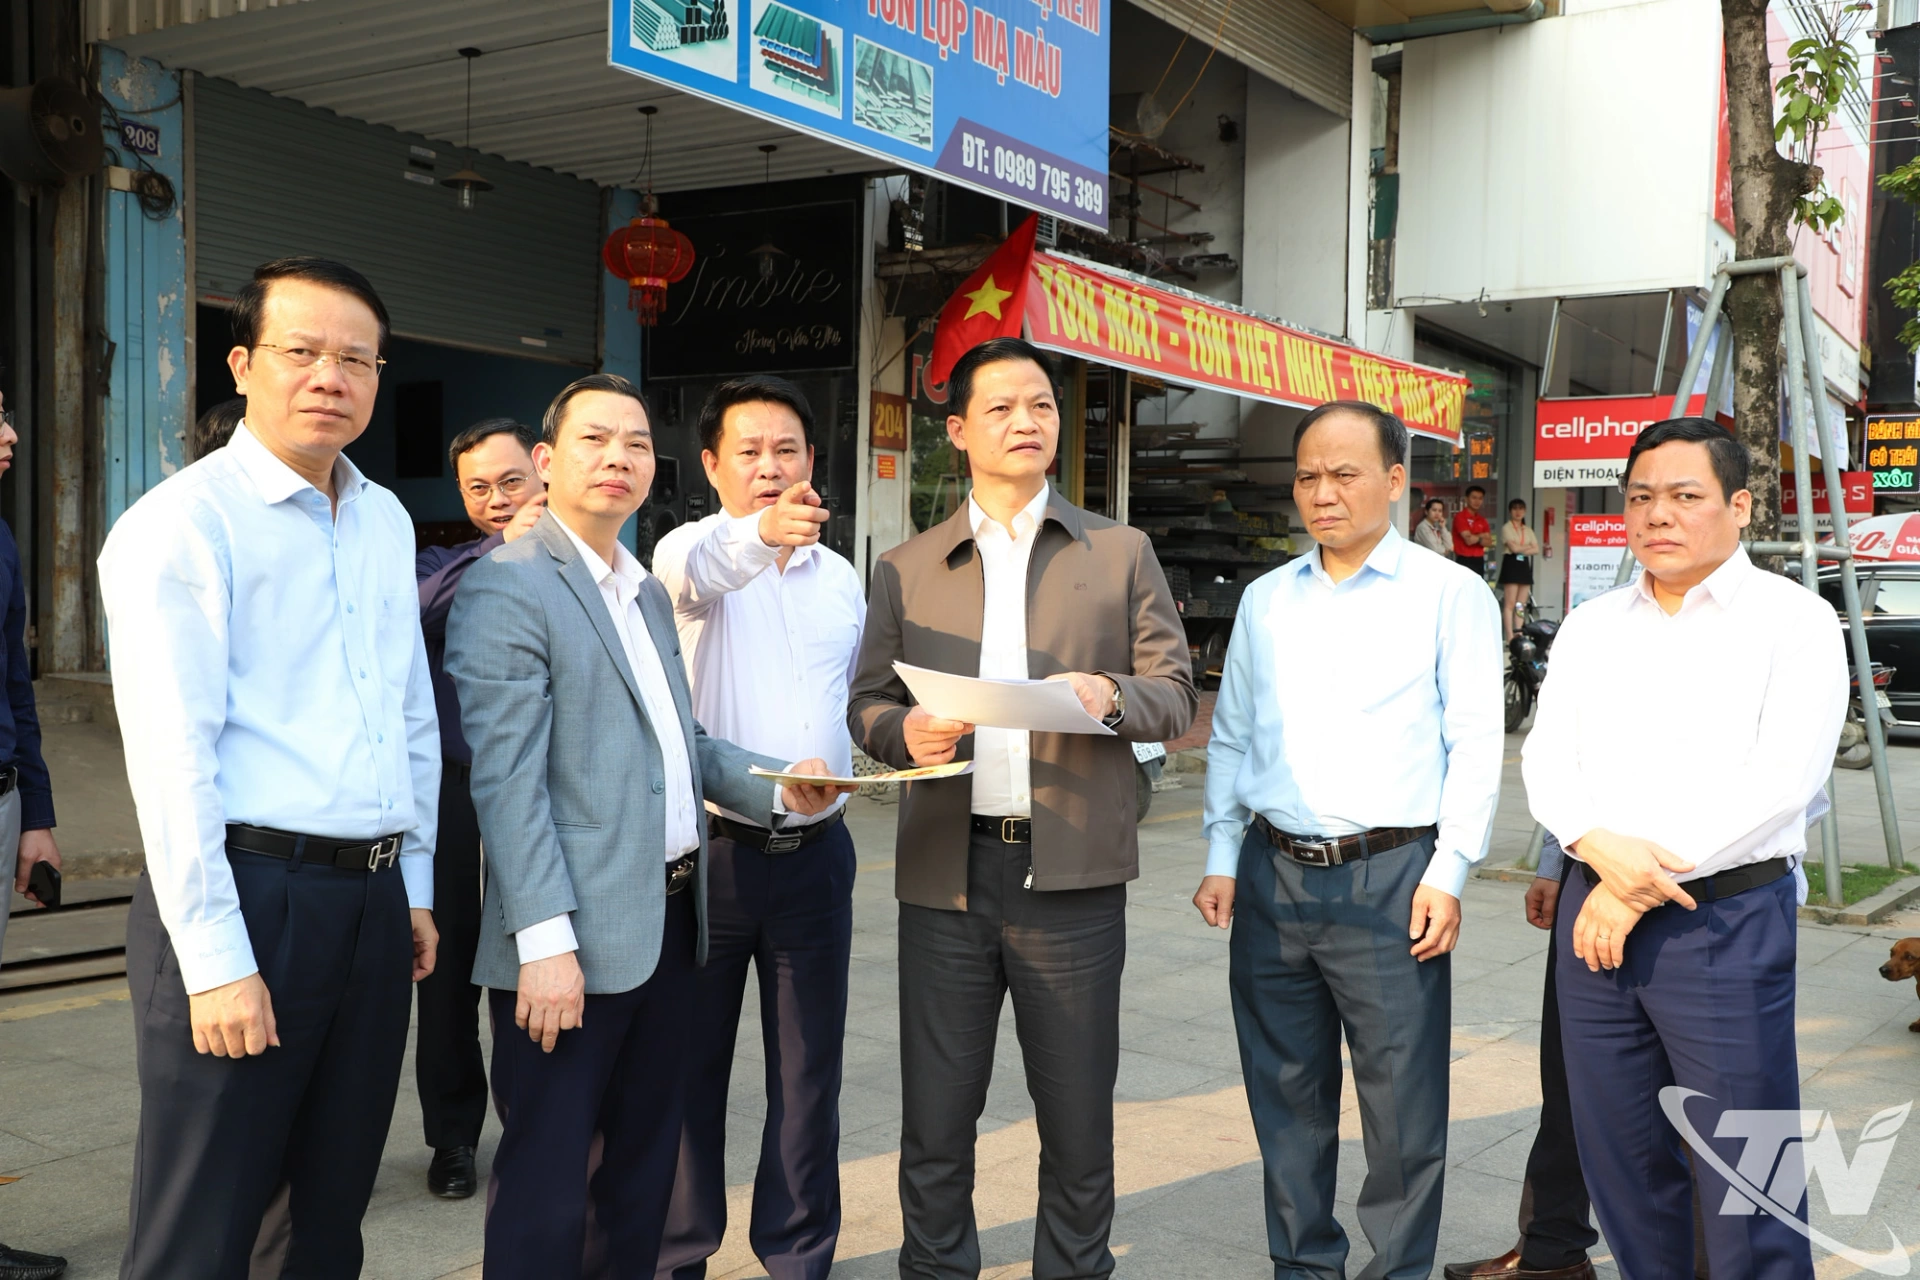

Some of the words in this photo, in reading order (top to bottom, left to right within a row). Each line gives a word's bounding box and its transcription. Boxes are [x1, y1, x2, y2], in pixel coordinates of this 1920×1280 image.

[973, 7, 1009, 86] MẠ
[1014, 27, 1062, 99] MÀU
[125, 125, 156, 151] 208
[962, 132, 989, 174] ĐT:
[994, 145, 1037, 191] 0989
[1040, 162, 1071, 203] 795
[1074, 176, 1103, 215] 389
[1036, 263, 1100, 347] TÔN
[1101, 287, 1162, 363] MÁT
[1181, 305, 1233, 380] TÔN
[1232, 321, 1282, 395] VIỆT
[875, 402, 904, 439] 204
[1868, 419, 1904, 440] BÁNH
[1543, 467, 1575, 483] ĐIỆN
[1578, 467, 1619, 482] THOẠI
[1872, 468, 1913, 488] XÔI
